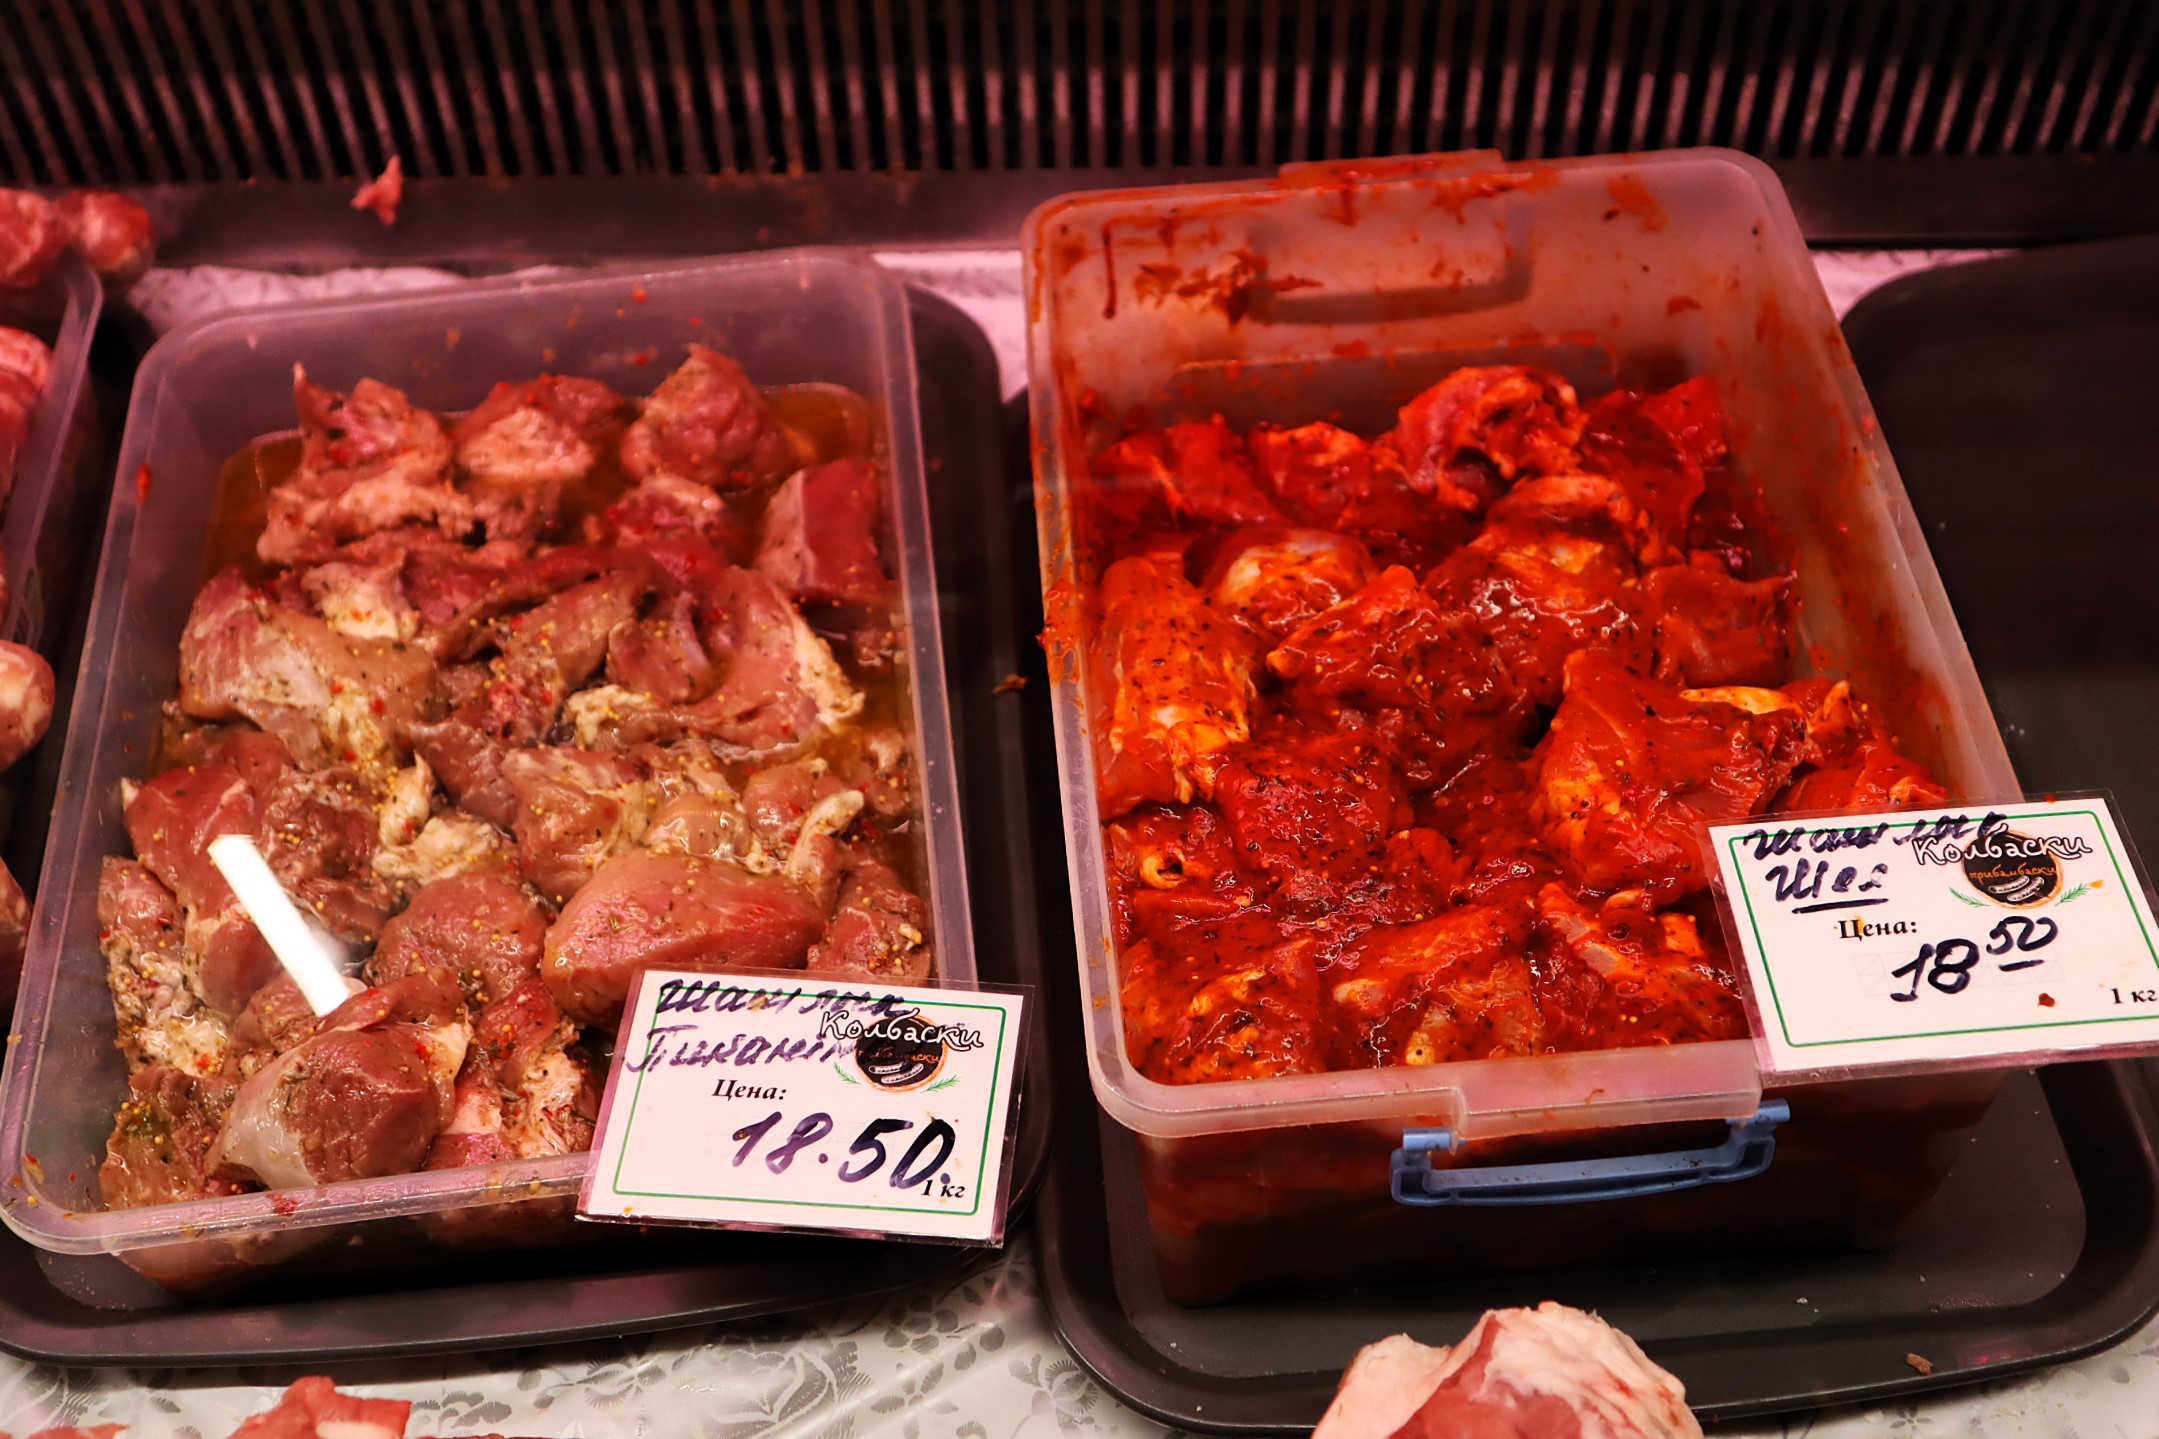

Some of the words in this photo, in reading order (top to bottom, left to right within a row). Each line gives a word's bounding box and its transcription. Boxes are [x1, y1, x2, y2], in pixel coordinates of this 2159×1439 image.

[1911, 823, 2093, 866] Колбаски
[1837, 918, 1918, 942] Цена:
[2110, 986, 2123, 1005] 1
[2131, 988, 2158, 1003] кг
[817, 1007, 984, 1052] Колбаски
[711, 1078, 788, 1101] Цена:
[921, 1178, 933, 1197] 1
[940, 1182, 966, 1199] кг
